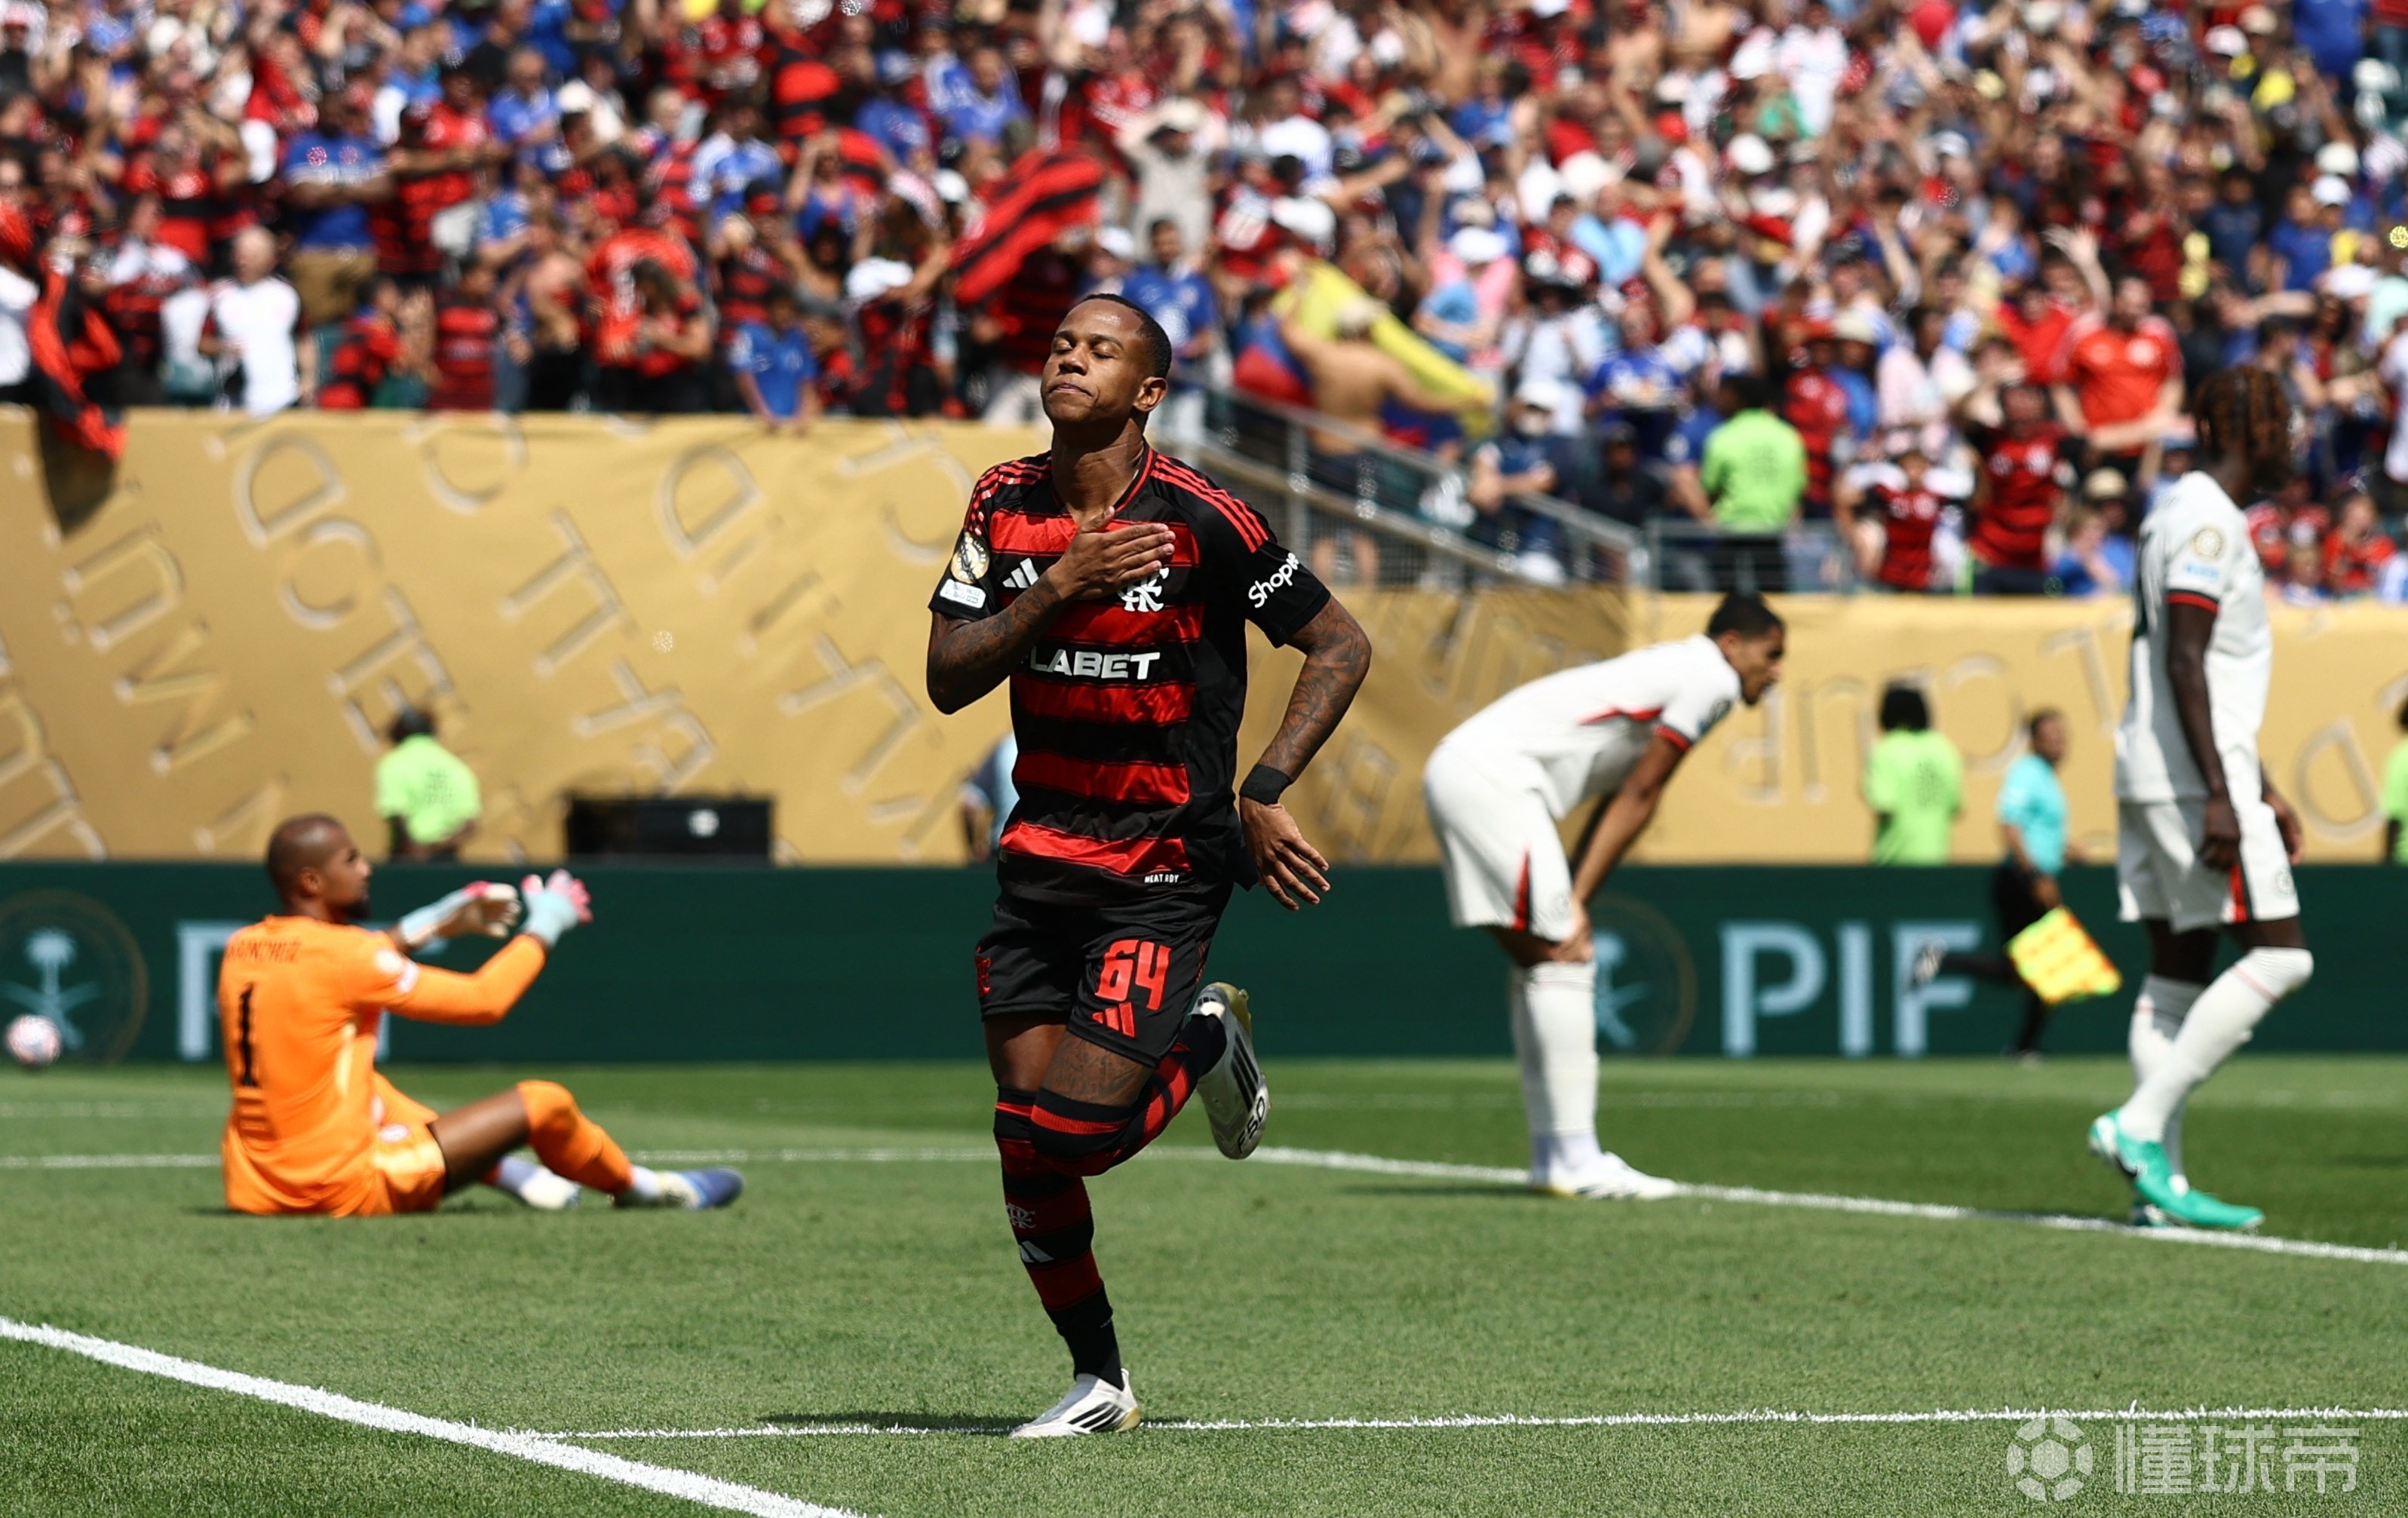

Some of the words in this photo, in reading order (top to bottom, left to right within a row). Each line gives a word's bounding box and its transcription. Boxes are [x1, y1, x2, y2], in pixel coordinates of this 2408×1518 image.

[1029, 646, 1161, 680] LABET
[1094, 939, 1172, 1010] 64
[1720, 921, 1983, 1056] PIF
[239, 981, 260, 1087] 1
